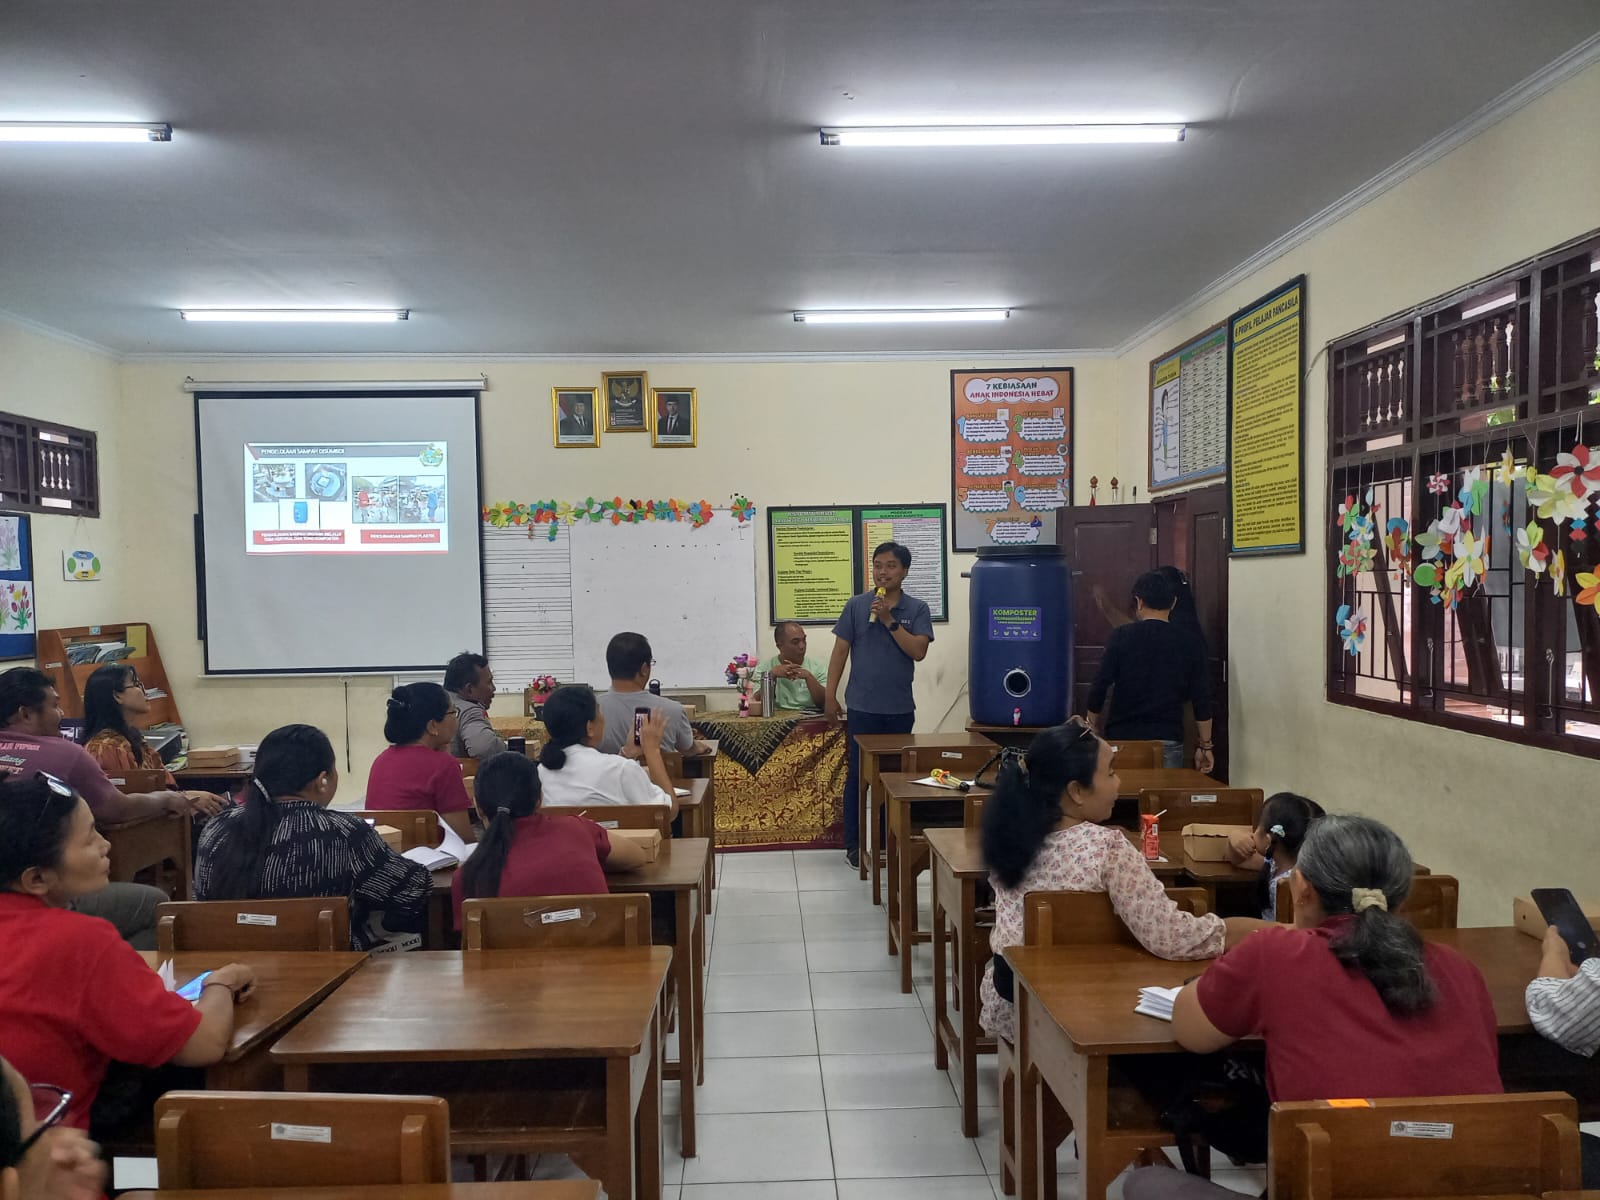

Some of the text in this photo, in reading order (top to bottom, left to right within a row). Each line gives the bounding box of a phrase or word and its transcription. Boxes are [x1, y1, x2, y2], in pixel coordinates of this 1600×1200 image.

[1238, 322, 1253, 336] PROFIL
[1253, 310, 1272, 327] PELAJAR
[1273, 295, 1298, 316] PANCASILA
[992, 382, 1038, 390] KEBIASAAN
[991, 390, 1030, 399] INDONESIA
[1031, 389, 1054, 397] HEBAT
